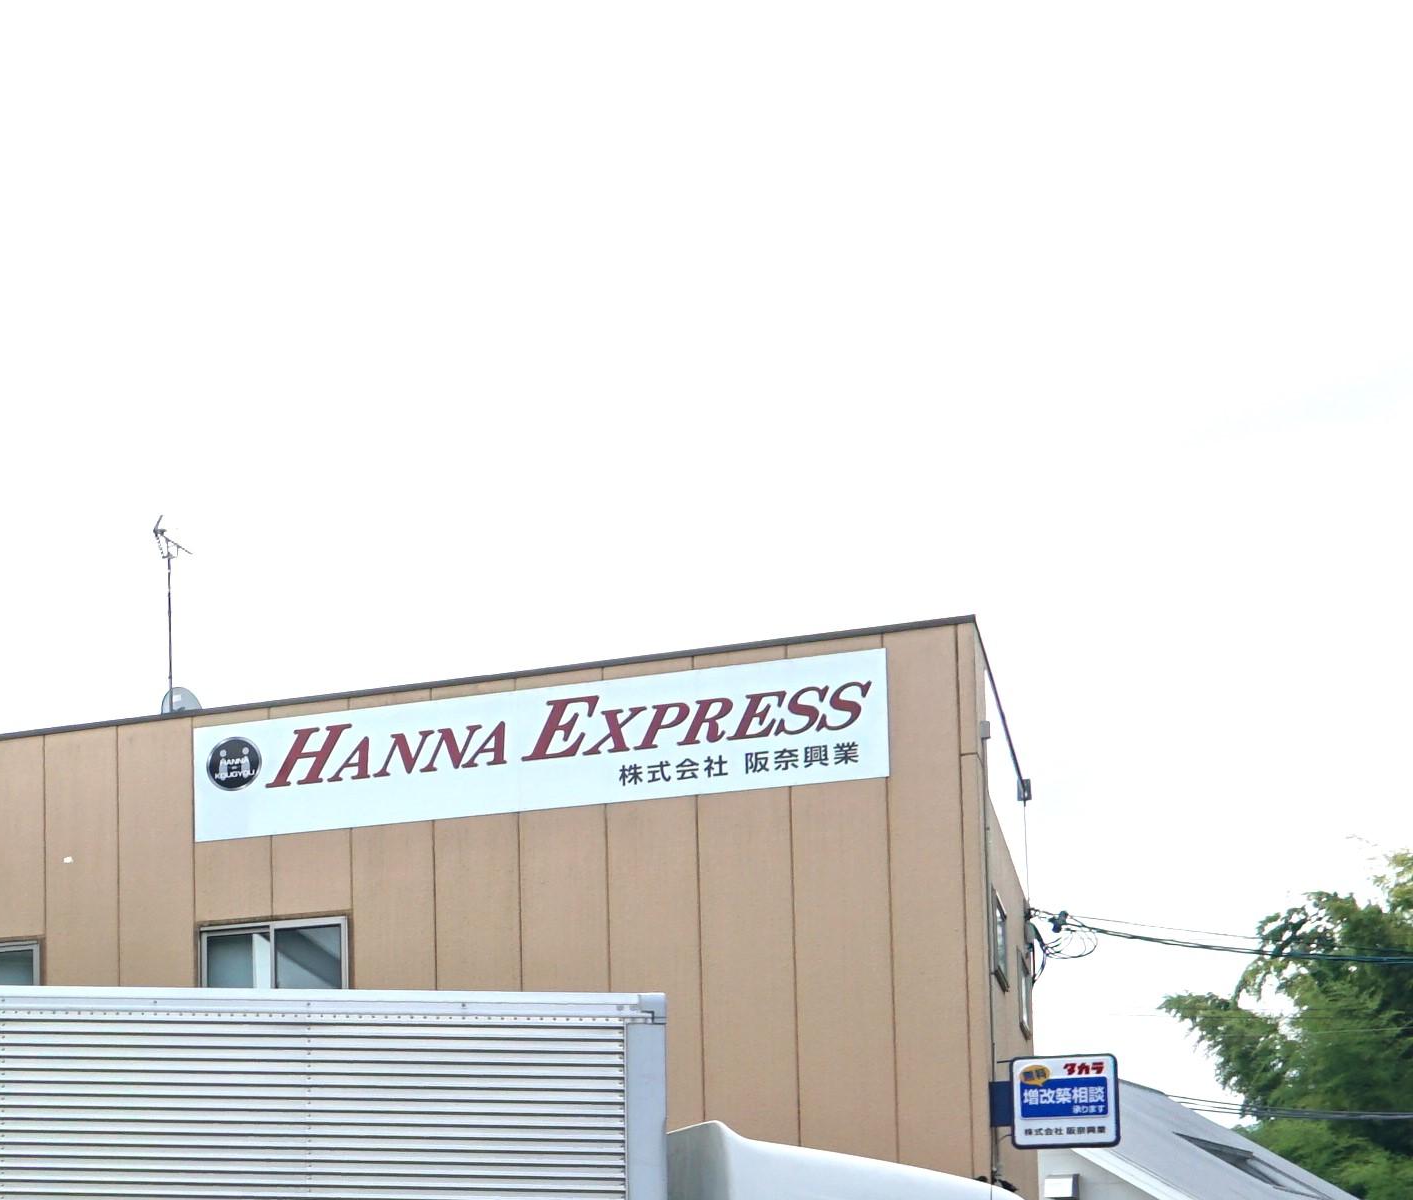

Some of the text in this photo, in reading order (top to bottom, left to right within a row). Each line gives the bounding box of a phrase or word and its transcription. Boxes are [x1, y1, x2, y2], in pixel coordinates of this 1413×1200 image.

[265, 680, 871, 788] HANNA EXPRESS
[619, 742, 860, 786] 株式会社 阪奈興業
[1063, 1062, 1104, 1075] タカラ
[1023, 1086, 1106, 1105] 増改築相談
